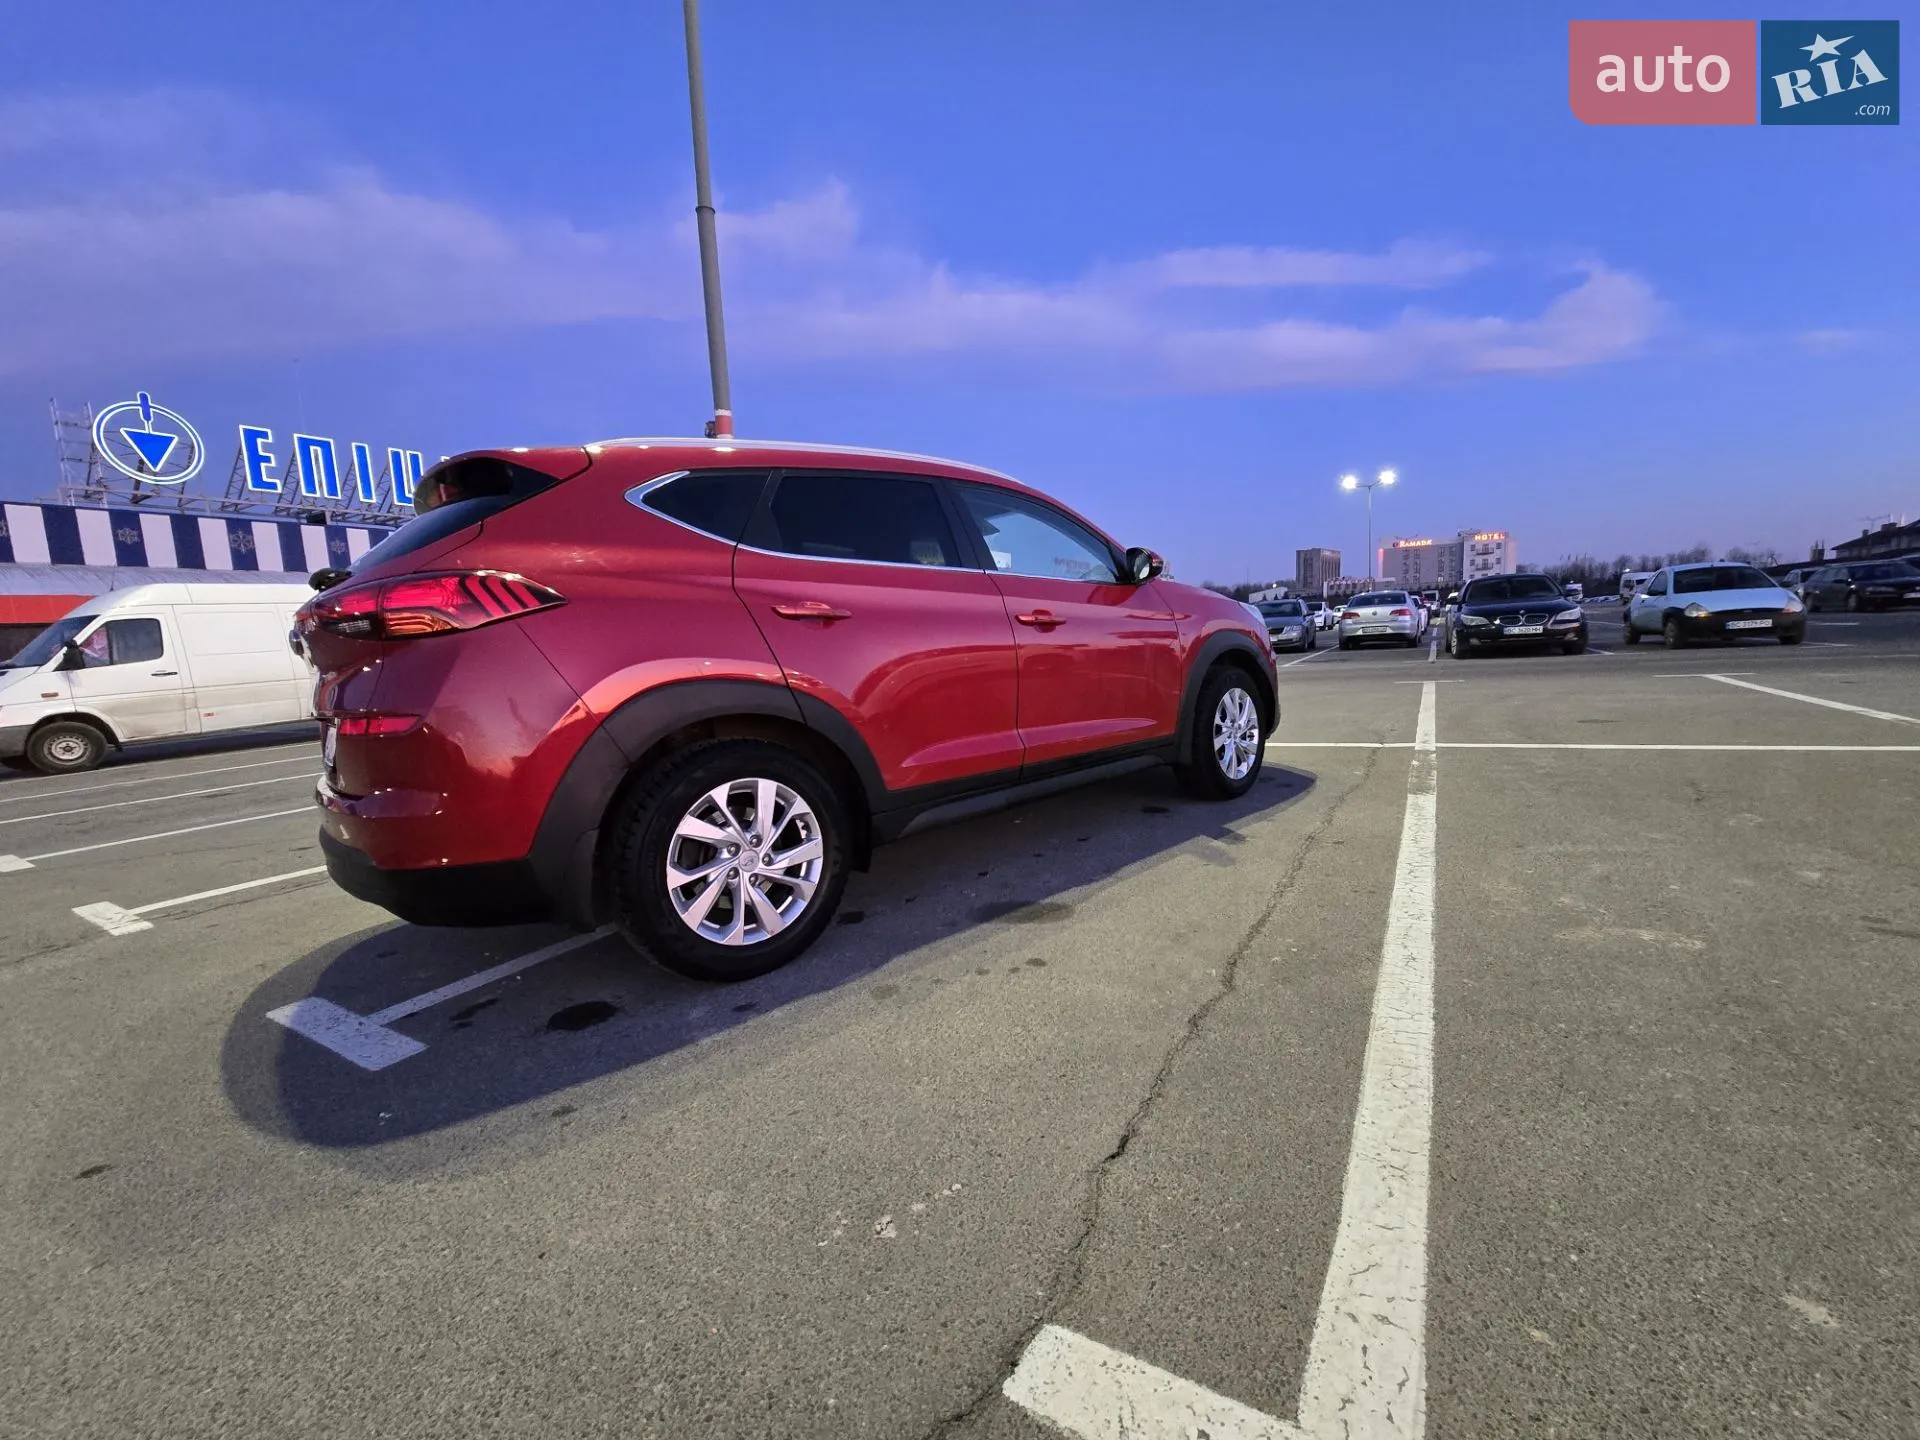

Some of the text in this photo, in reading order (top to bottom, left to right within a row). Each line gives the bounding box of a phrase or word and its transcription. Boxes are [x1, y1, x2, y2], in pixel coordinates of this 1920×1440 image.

[238, 424, 450, 507] ЕПІЦ
[1474, 533, 1505, 541] HOTEL
[1399, 539, 1433, 548] RAMADA
